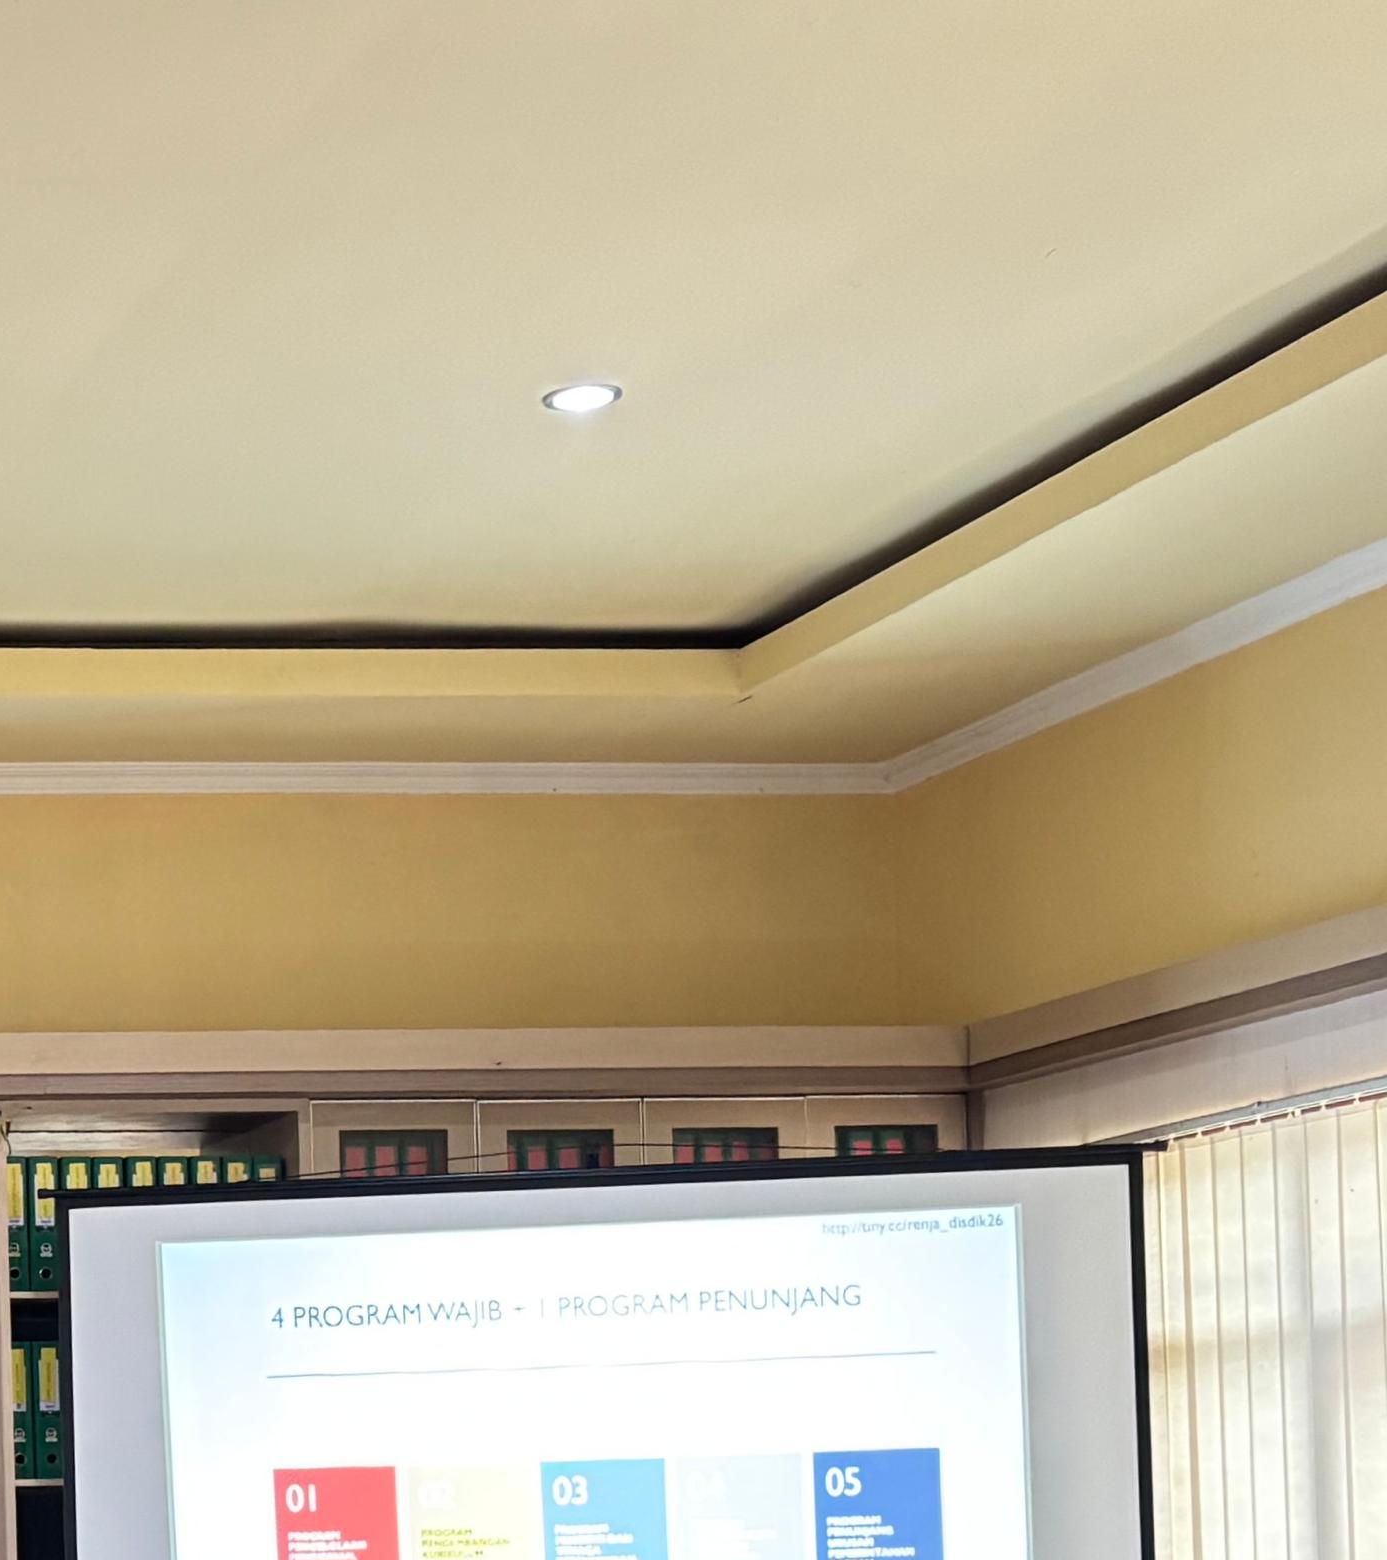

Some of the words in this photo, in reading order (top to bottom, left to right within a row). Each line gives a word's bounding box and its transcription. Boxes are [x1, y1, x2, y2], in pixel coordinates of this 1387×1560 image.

[271, 1307, 284, 1328] 4
[293, 1303, 422, 1328] PROGRAM
[427, 1299, 503, 1328] WAJIB
[558, 1291, 689, 1317] PROGRAM
[699, 1284, 862, 1316] PENUNJANG
[552, 1474, 588, 1505] 03
[825, 1466, 862, 1498] 05
[285, 1483, 317, 1513] 01
